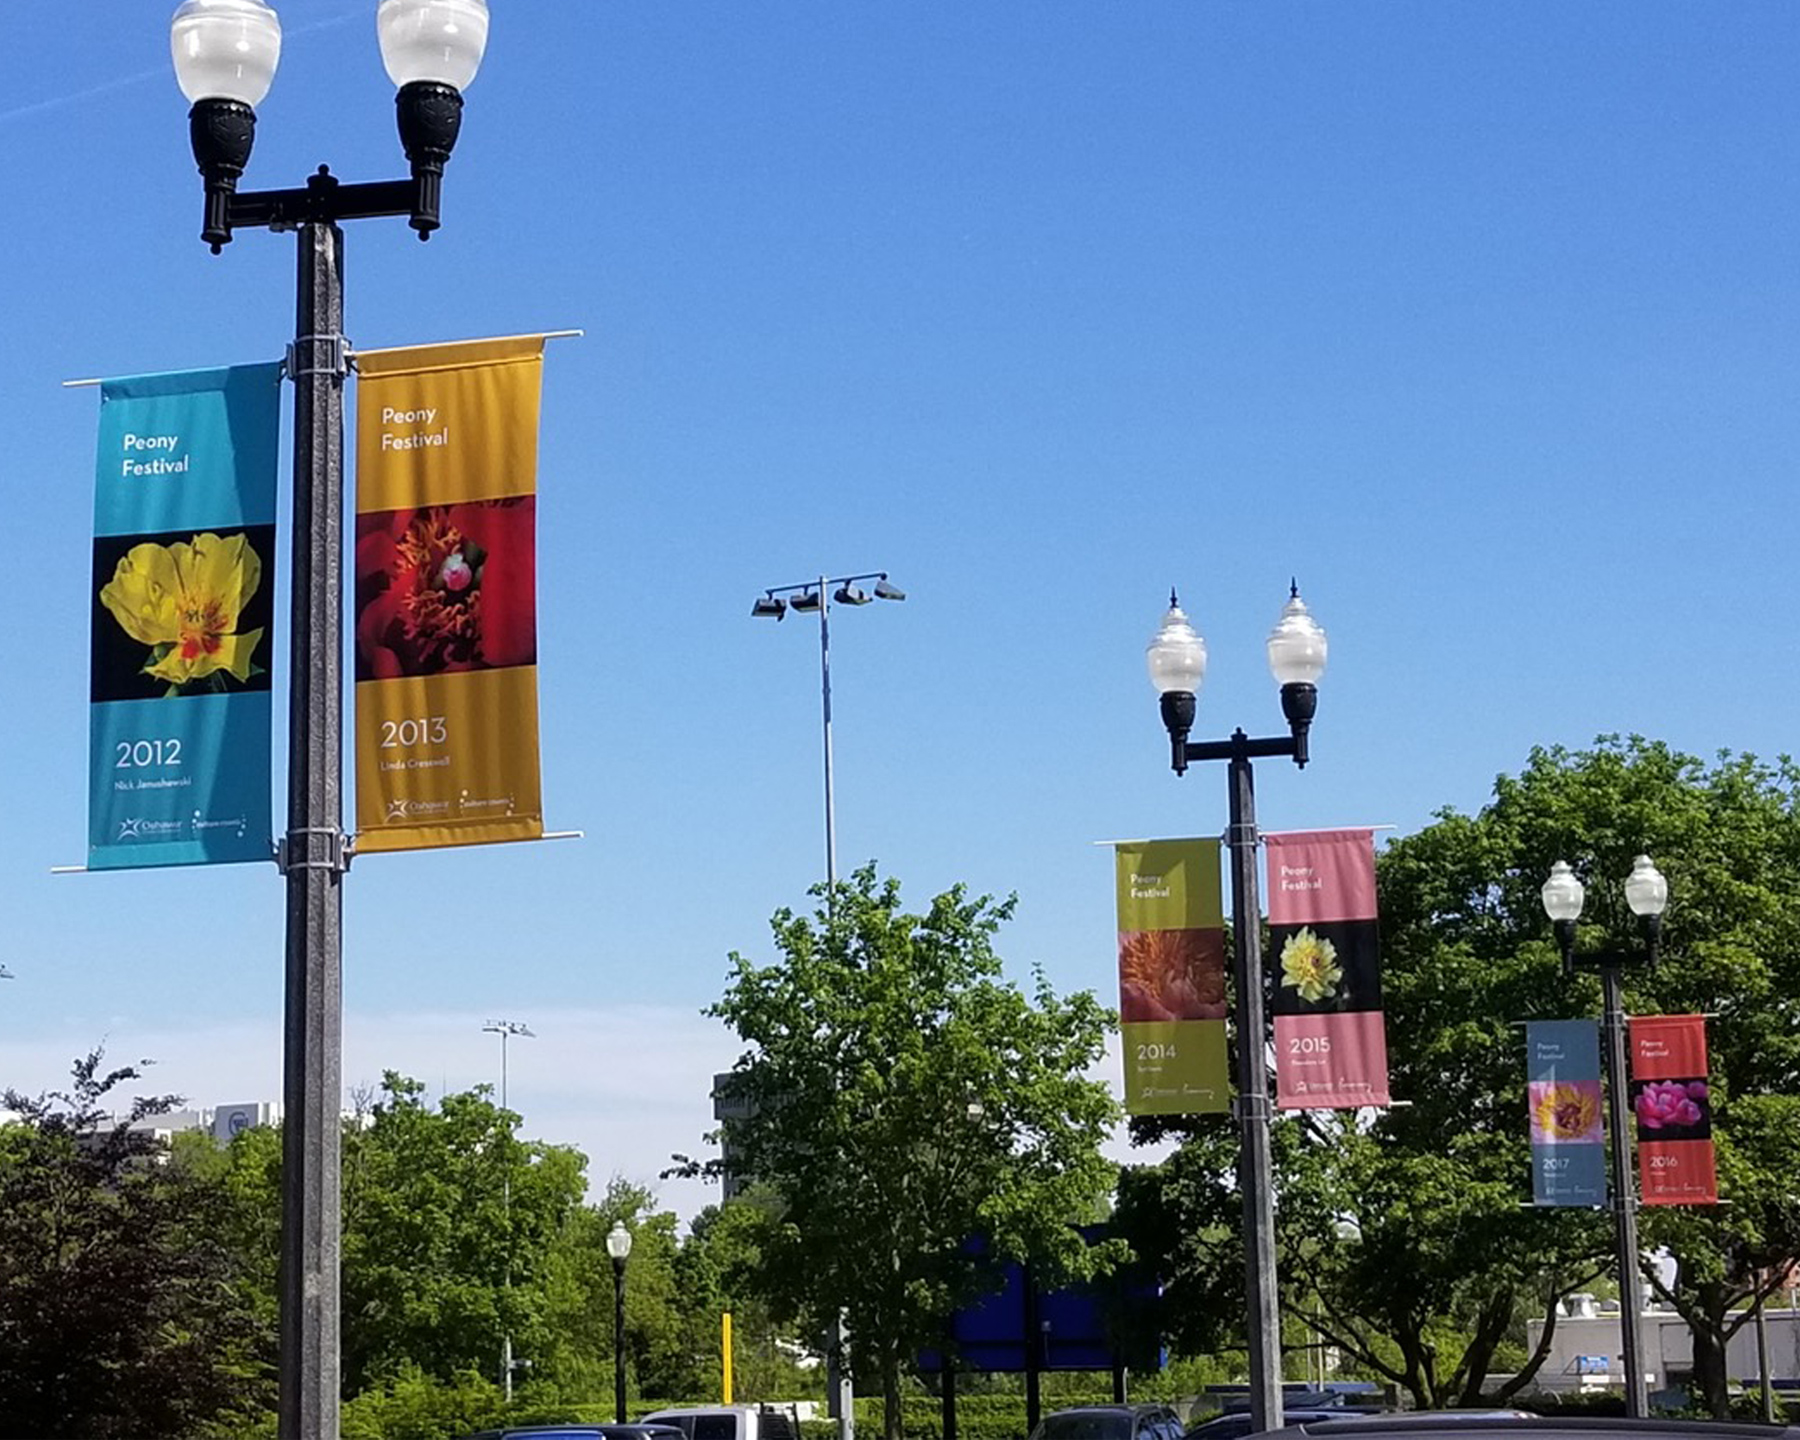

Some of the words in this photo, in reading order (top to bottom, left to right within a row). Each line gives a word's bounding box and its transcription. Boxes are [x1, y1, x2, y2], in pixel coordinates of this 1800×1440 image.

[382, 407, 437, 425] Peony
[122, 433, 179, 453] Peony
[381, 426, 449, 451] Festival
[122, 453, 190, 478] Festival
[380, 716, 447, 748] 2013
[115, 738, 182, 768] 2012
[1130, 886, 1171, 899] Festival
[1281, 877, 1323, 891] Festival
[1137, 1044, 1177, 1060] 2014
[1290, 1036, 1332, 1054] 2015
[1542, 1158, 1570, 1170] 2017
[1649, 1156, 1679, 1168] 2016
